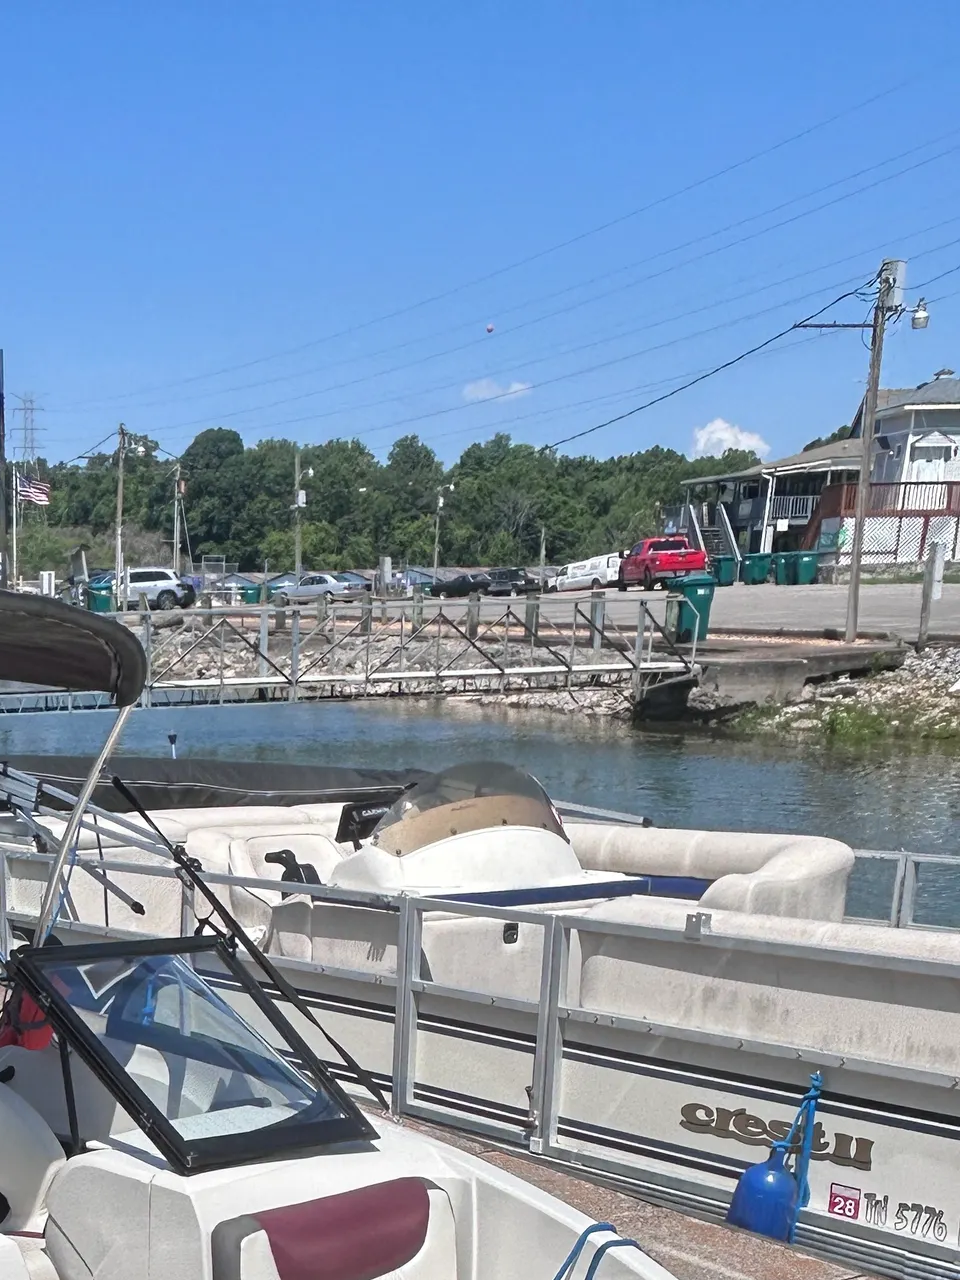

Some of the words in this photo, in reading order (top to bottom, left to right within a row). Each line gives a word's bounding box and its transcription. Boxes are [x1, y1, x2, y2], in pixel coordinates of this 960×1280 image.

[833, 1196, 856, 1217] 28
[864, 1193, 889, 1226] TN
[894, 1202, 948, 1242] 5776
